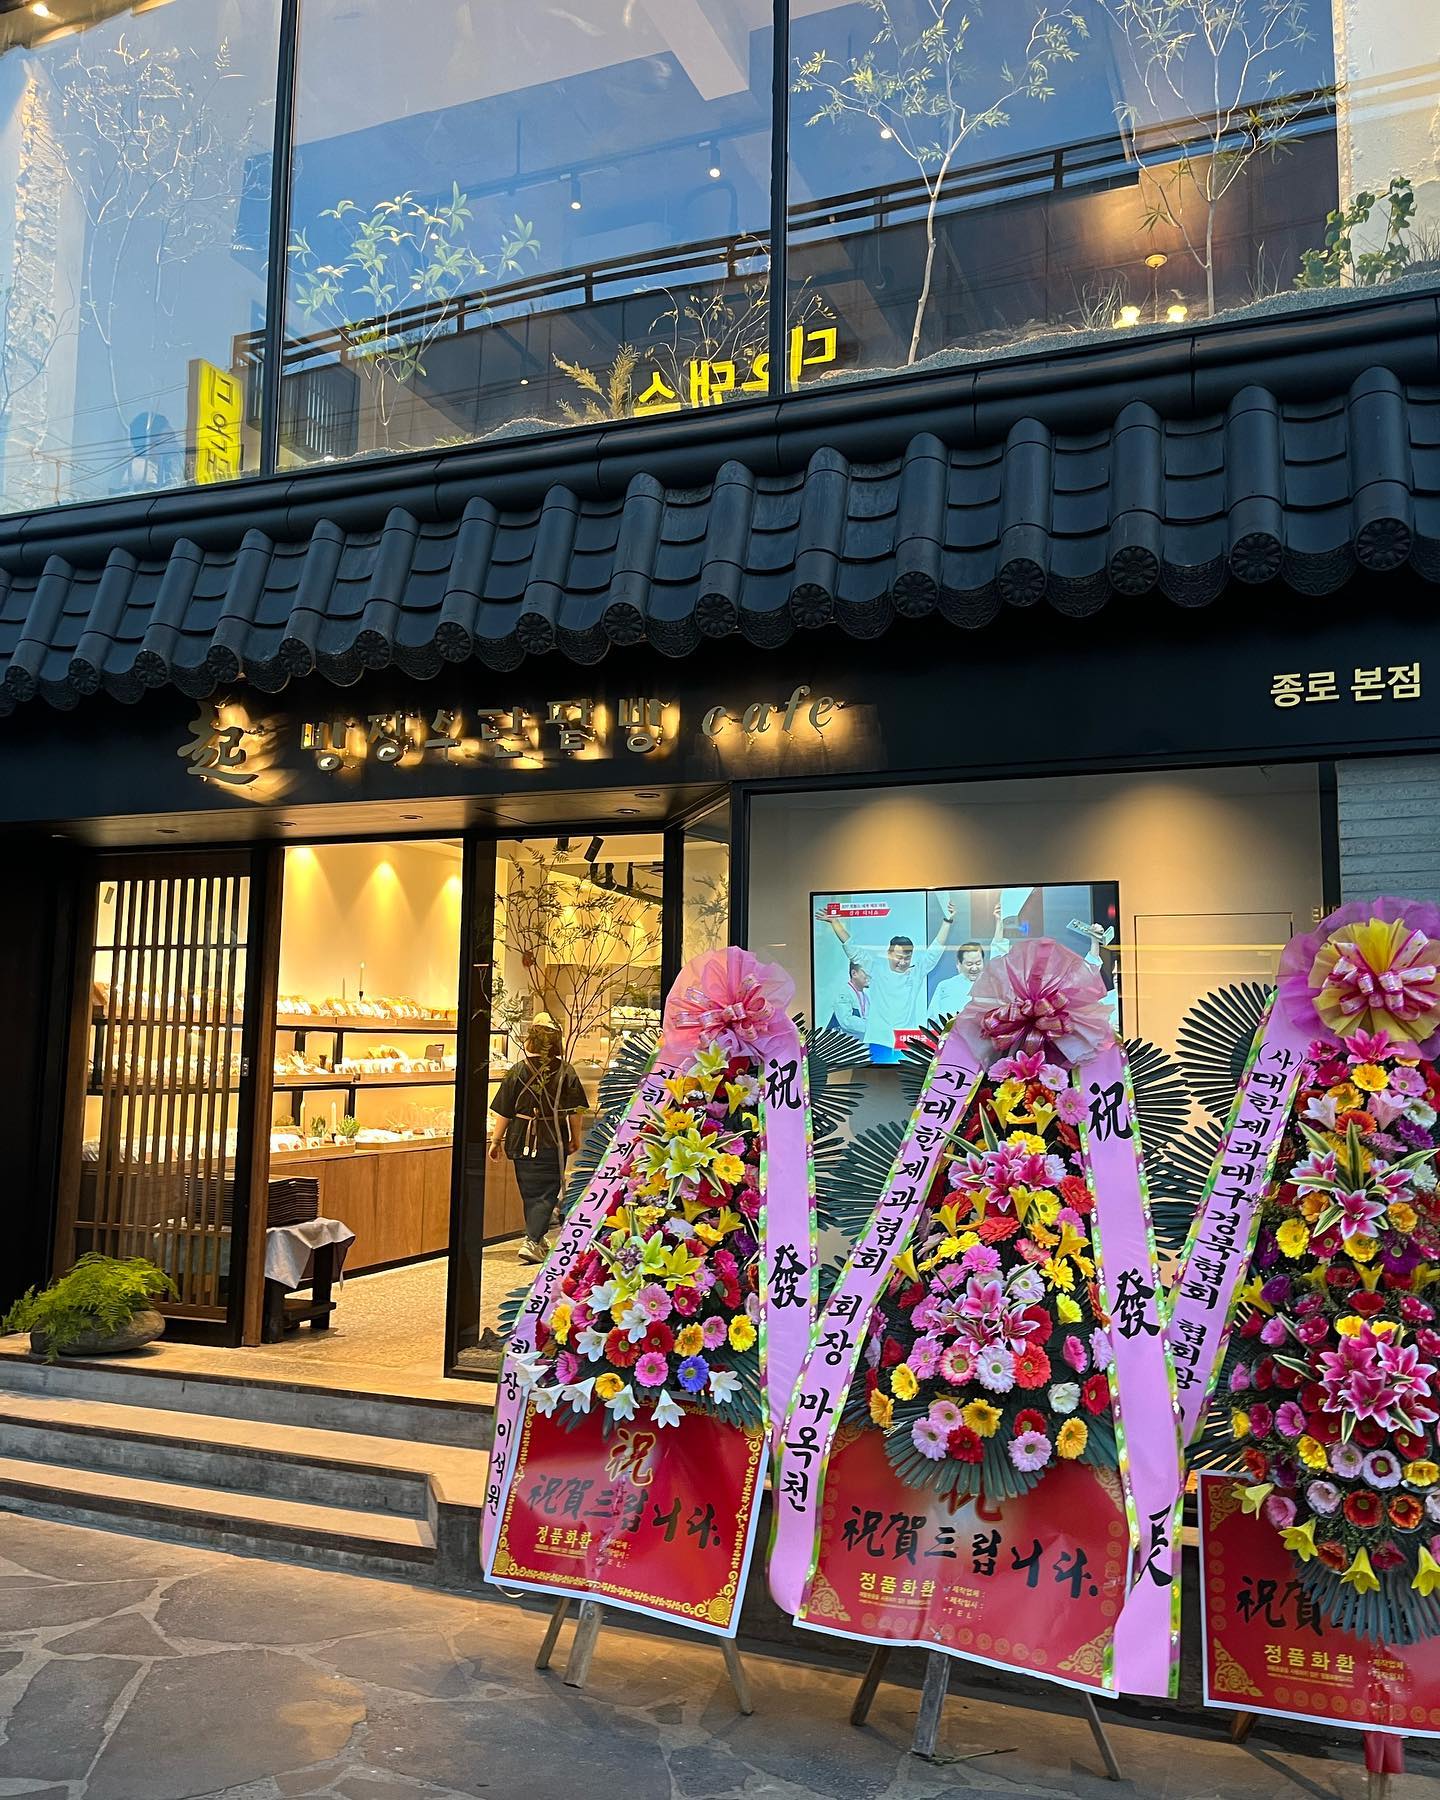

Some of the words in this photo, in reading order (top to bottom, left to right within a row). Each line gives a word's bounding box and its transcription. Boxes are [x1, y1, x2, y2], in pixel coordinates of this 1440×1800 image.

[1270, 671, 1340, 707] 종로
[1350, 662, 1421, 702] 본점
[701, 685, 835, 737] cafe
[766, 1058, 801, 1110] 祝
[1088, 1081, 1134, 1141] 祝
[1111, 1268, 1161, 1339] 發
[768, 1243, 808, 1309] 發
[816, 1295, 863, 1366] 회장
[605, 1428, 657, 1487] 祝
[781, 1387, 834, 1513] 마옥천
[536, 1525, 593, 1549] 정품화환
[859, 1571, 936, 1597] 정품화환
[1264, 1644, 1356, 1674] 정품화환
